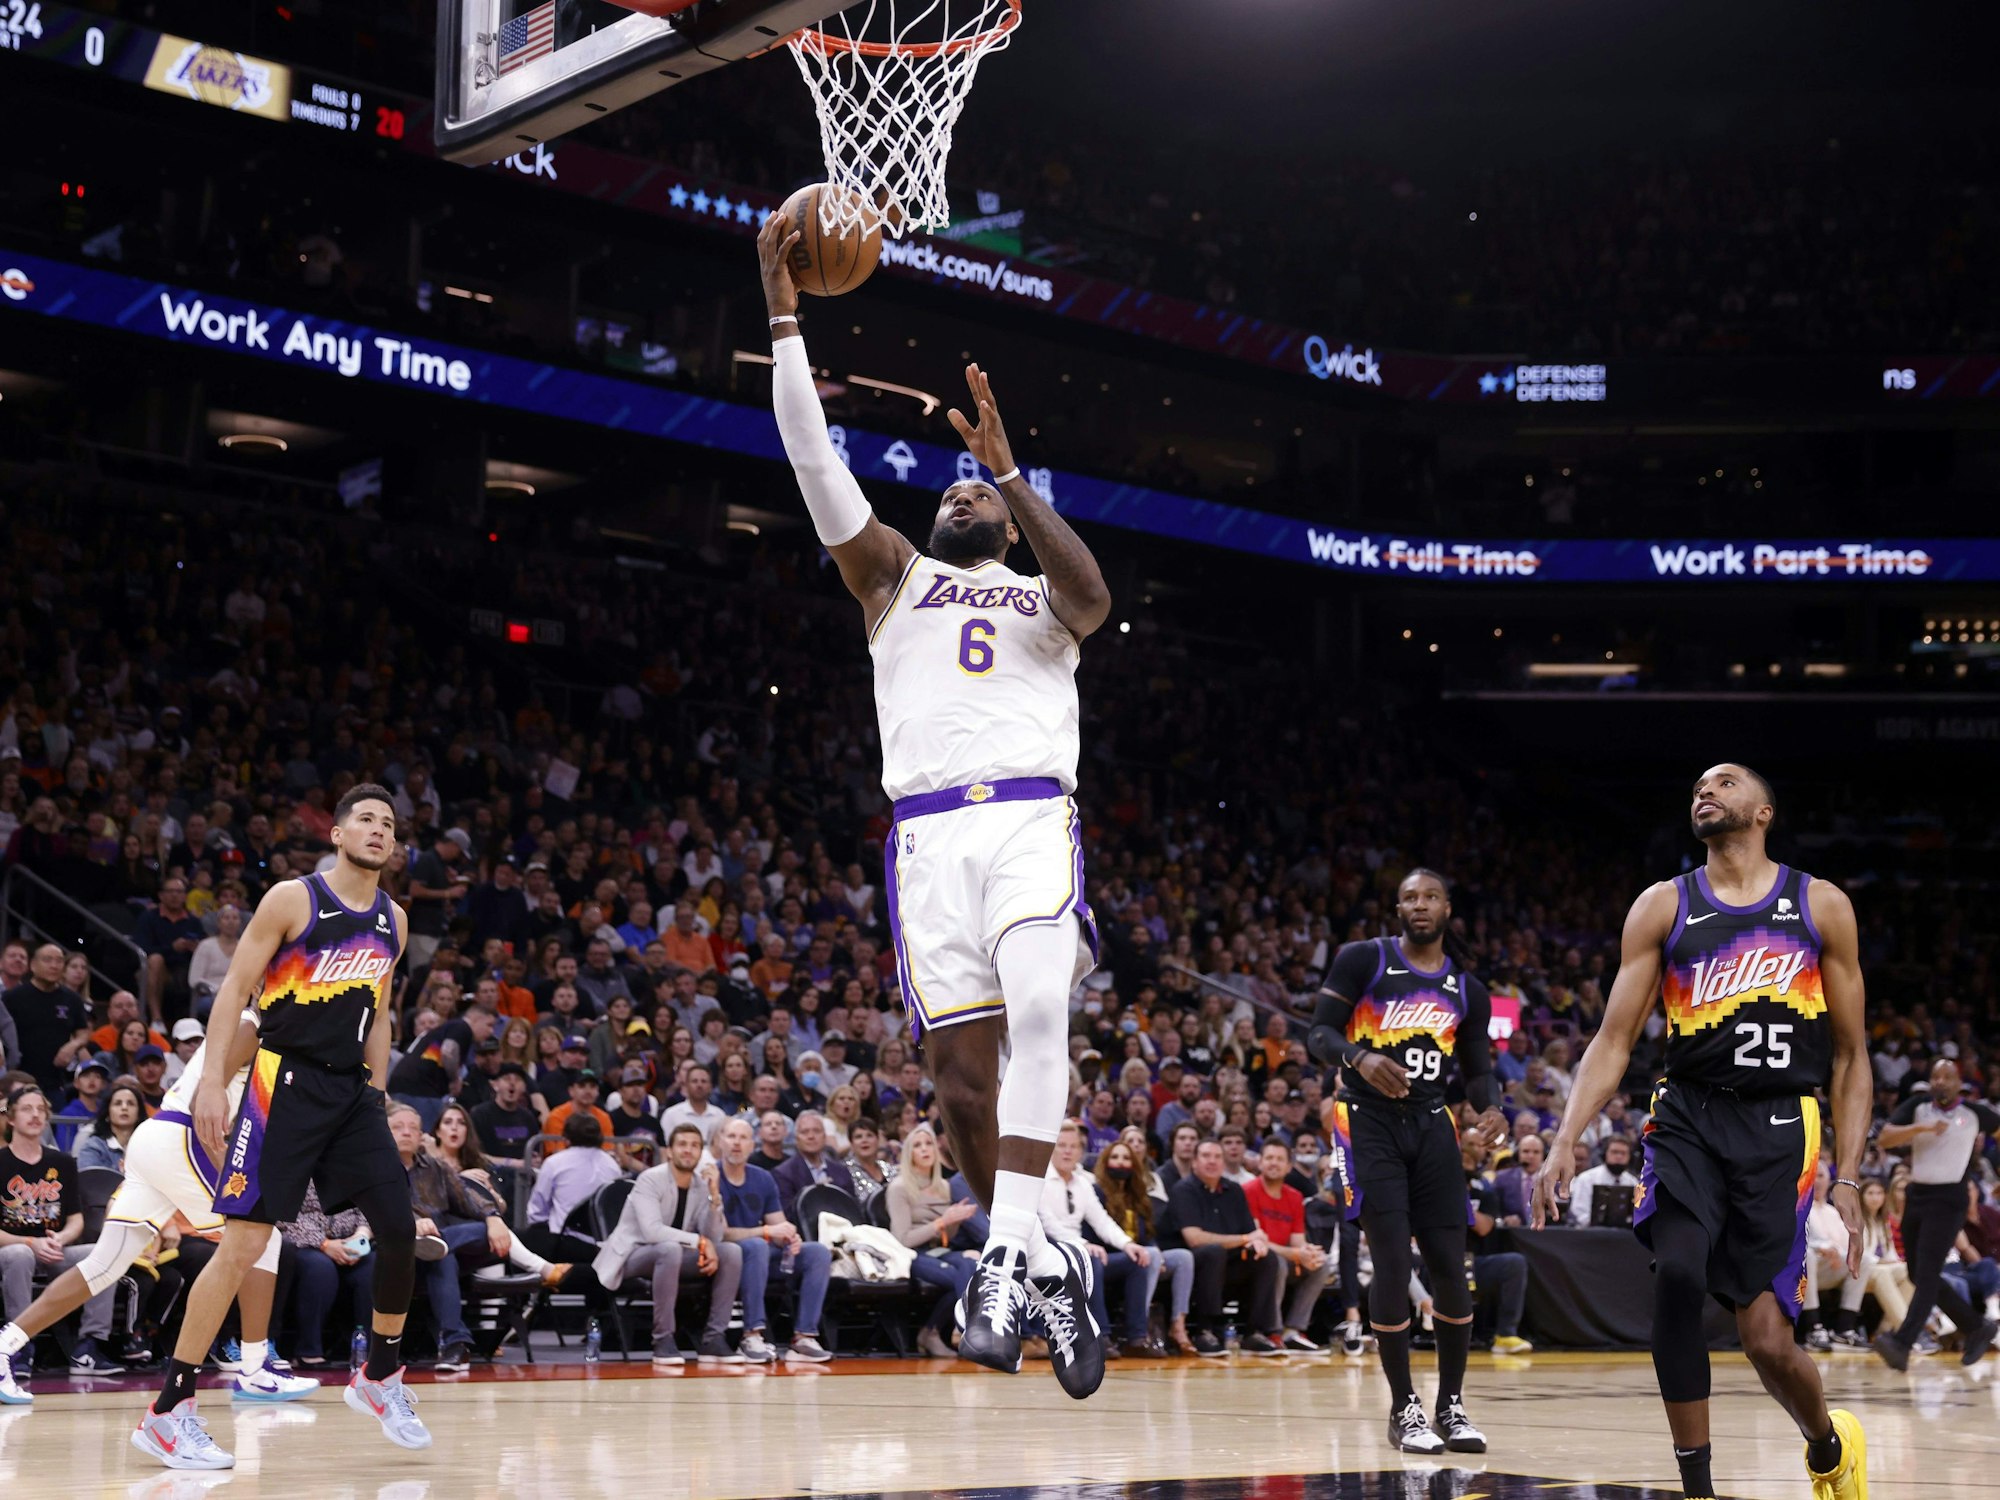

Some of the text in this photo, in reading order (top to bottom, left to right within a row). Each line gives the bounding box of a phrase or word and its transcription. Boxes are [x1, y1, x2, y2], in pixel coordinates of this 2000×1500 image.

[85, 26, 104, 66] 0
[291, 100, 360, 131] TIMEOUTS 7
[312, 83, 361, 111] FOULS 0
[376, 106, 404, 139] 20
[160, 292, 471, 391] Work Any Time
[1304, 335, 1382, 386] Qwick
[1883, 368, 1916, 390] ns
[1307, 528, 1536, 575] Work Full Time
[1650, 544, 1928, 575] Work Part Time
[912, 573, 1041, 617] LAKERS
[957, 618, 997, 677] 6
[1772, 913, 1800, 921] PayPal
[309, 948, 392, 988] Valley
[338, 951, 355, 960] THE
[1717, 957, 1739, 972] THE
[1690, 946, 1805, 1008] Valley
[357, 1006, 370, 1043] 1
[1379, 1000, 1457, 1037] Valley
[1404, 1046, 1442, 1081] 99
[1734, 1022, 1794, 1069] 25
